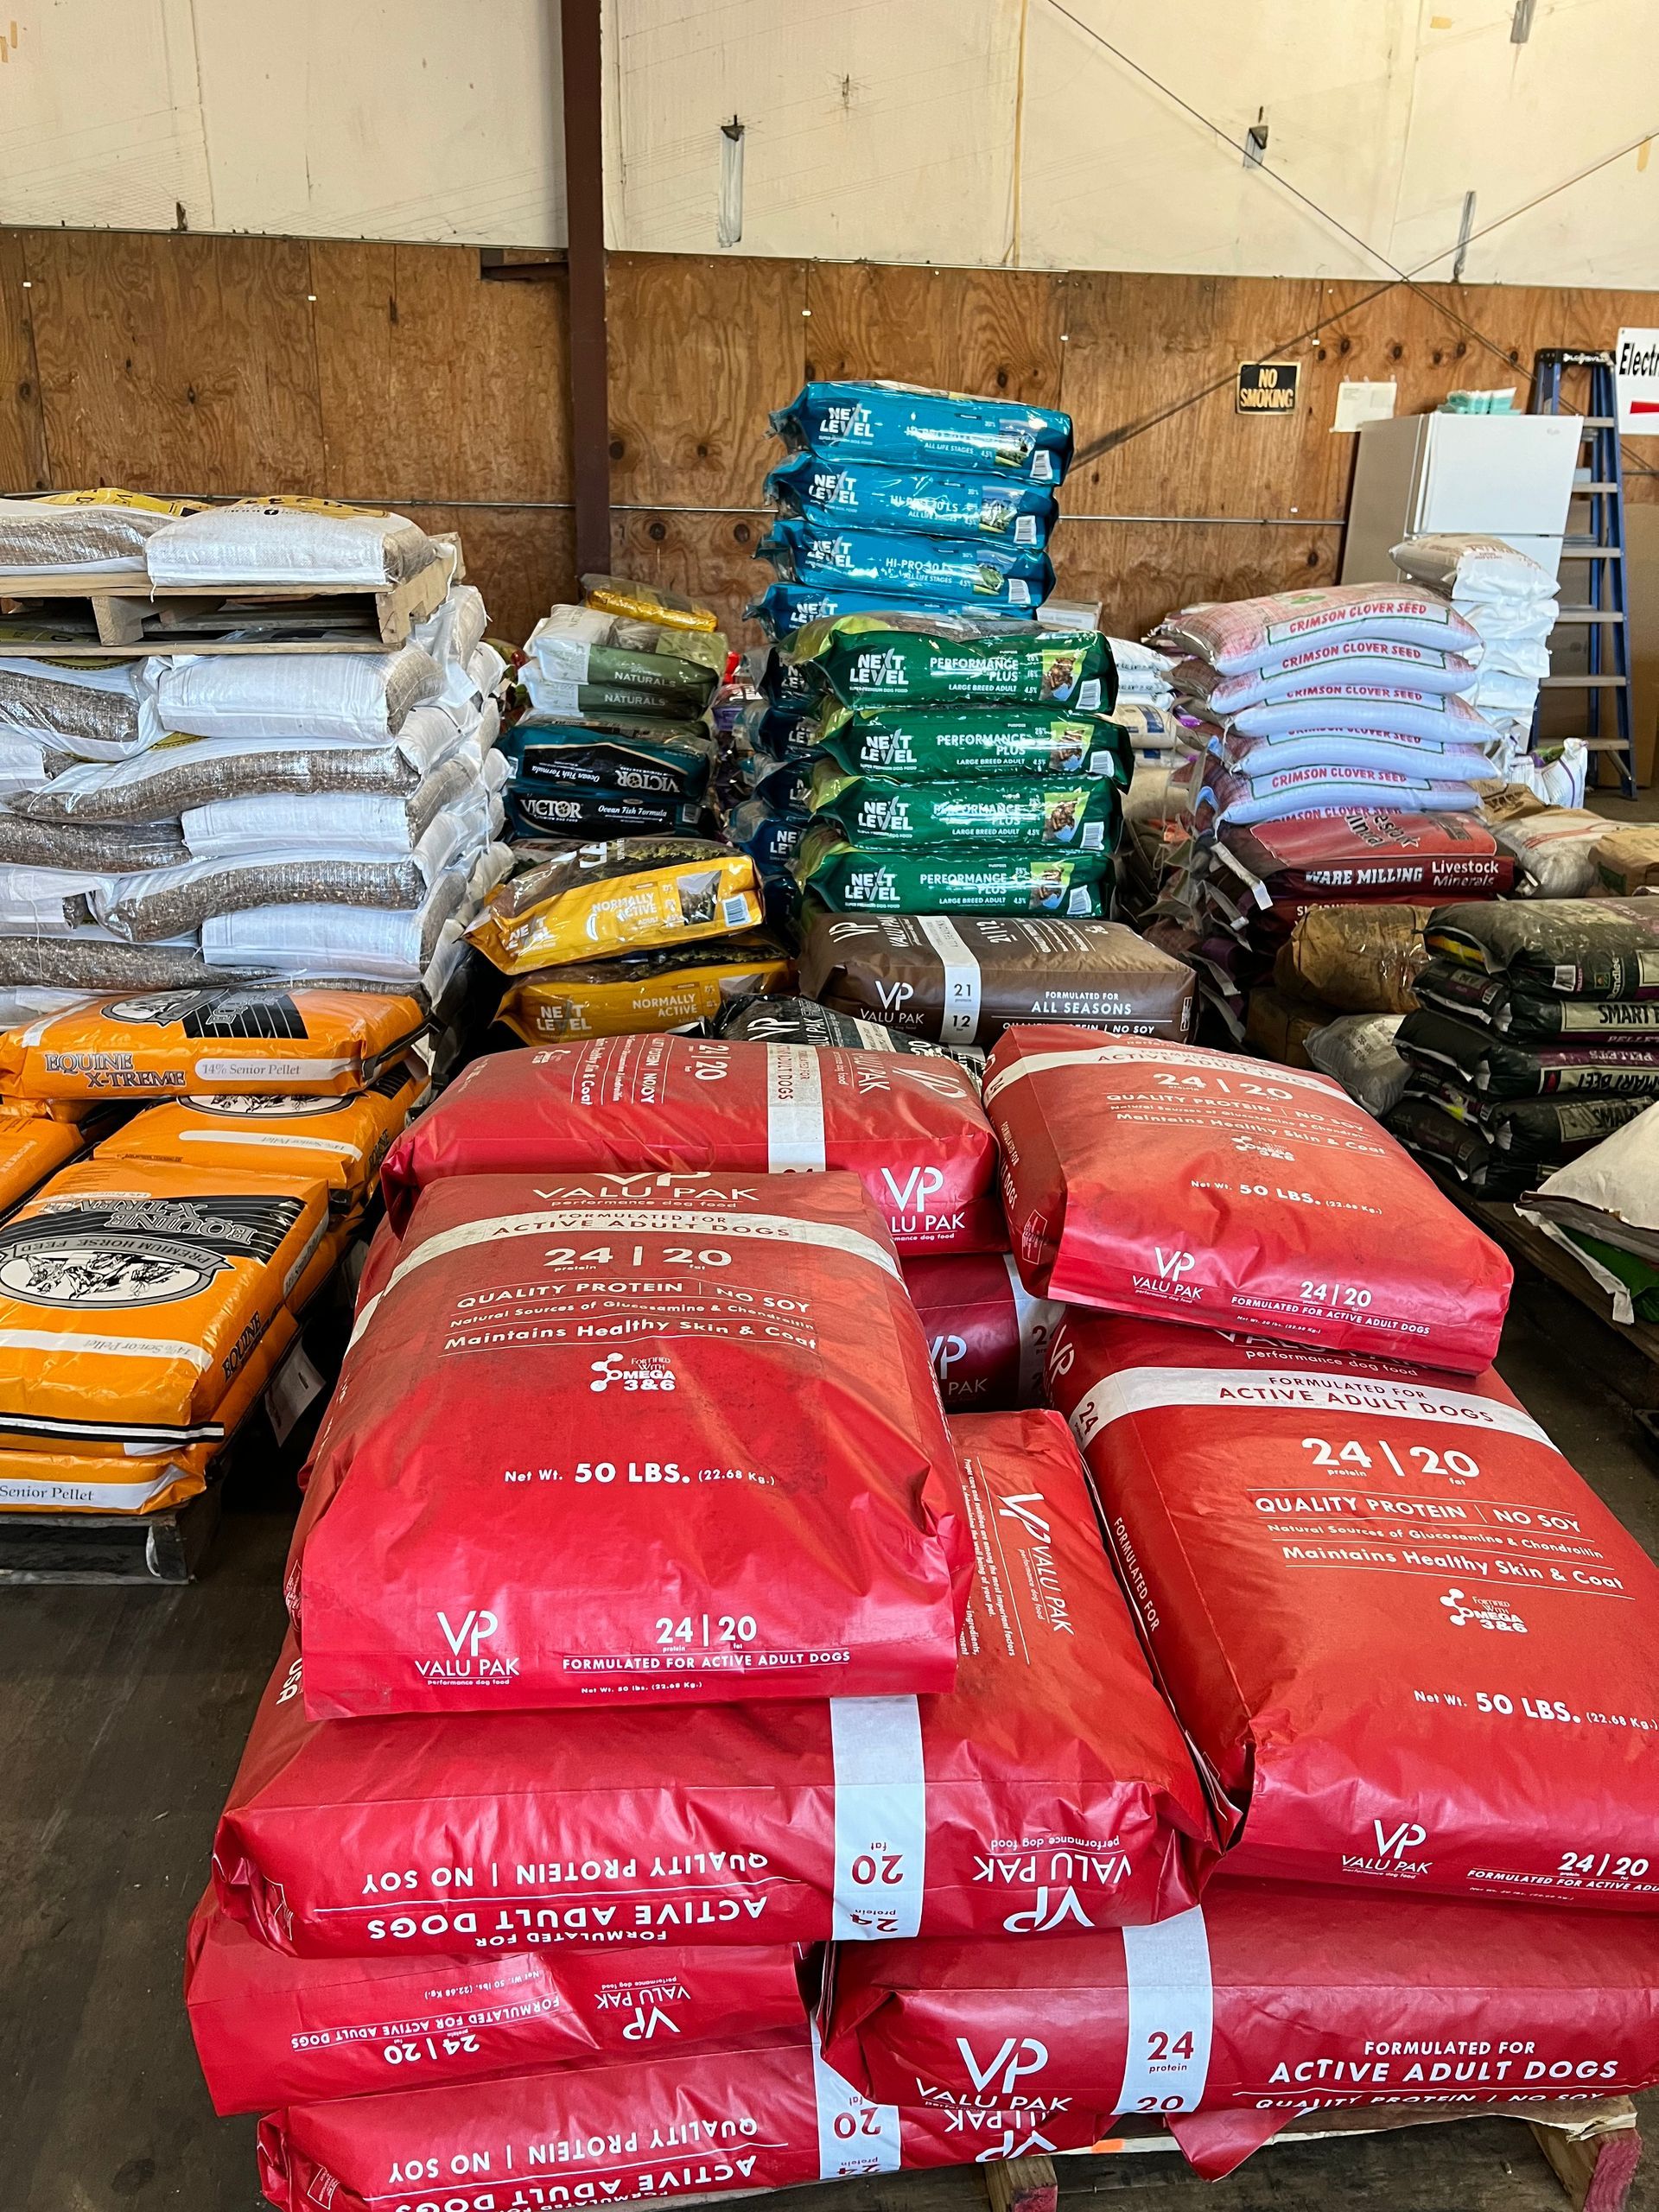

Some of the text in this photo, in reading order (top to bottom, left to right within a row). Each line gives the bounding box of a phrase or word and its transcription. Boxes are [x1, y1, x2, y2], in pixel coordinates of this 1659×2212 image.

[1258, 368, 1278, 388] NO
[1240, 388, 1294, 408] SMOKING
[819, 419, 874, 438] LEVEL
[934, 443, 950, 452] LIFE
[950, 445, 974, 454] STAGES
[1289, 602, 1427, 633] CRIMSON CLOVER SEED
[930, 657, 1019, 671] PERFORMANCE
[1281, 643, 1421, 669] CRIMSON CLOVER SEED
[614, 671, 677, 688] NATURALS
[849, 667, 909, 685] LEVEL
[988, 671, 1019, 683] PLUS
[972, 683, 994, 692] BREED
[1345, 686, 1390, 698] CLOVER
[1393, 691, 1423, 701] SEED
[604, 693, 667, 707] NATURALS
[937, 734, 1027, 747] PERFORMANCE
[861, 747, 917, 764] LEVEL
[996, 745, 1026, 756] PLUS
[614, 769, 681, 793] VICTOR
[1272, 766, 1408, 789] CRIMSON CLOVER SEED
[520, 799, 583, 819] VICTOR
[598, 804, 620, 814] Ocean
[857, 812, 913, 831] LEVEL
[1432, 861, 1499, 874] Livestock
[1305, 868, 1423, 886] WARE MILLING
[1433, 874, 1495, 887] Minerals
[844, 885, 900, 901] LEVEL
[592, 893, 655, 912] NORMALLY
[874, 980, 914, 1011] VP
[953, 983, 973, 997] 21
[1045, 991, 1119, 1001] FORMULATED FOR
[632, 994, 696, 1010] NORMALLY
[1030, 1001, 1133, 1016] ALL SEASONS
[658, 1004, 698, 1018] ACTIVE
[860, 1007, 926, 1024] VALU PAK
[1599, 1002, 1649, 1025] SMART
[951, 1014, 971, 1028] 12
[1112, 1023, 1156, 1035] NO SOY
[45, 1052, 134, 1073] EQUINE
[1588, 1049, 1654, 1062] PELLETS
[202, 1064, 302, 1076] 14% Senior Pellet
[87, 1071, 186, 1088] X-TREME
[531, 1186, 761, 1201] VALU PAK
[880, 1166, 944, 1213] VP
[557, 1212, 683, 1221] FORMULATED
[925, 1211, 965, 1231] PAK
[104, 1211, 259, 1245] EQUINE
[491, 1219, 791, 1236] ACTIVE ADULT DOGS
[21, 1237, 211, 1264] PREMIUM HORSE FEED
[543, 1247, 733, 1267] 24 20
[456, 1282, 812, 1314] QUALITY PROTEIN NO SOY
[449, 1300, 815, 1331] Natural Sources of Glucosamine & Chondroitin
[1230, 1296, 1431, 1336] FORMULATED FOR ACTIVE ADULT DOGS
[443, 1319, 817, 1351] Maintains Healthy Skin & Coat
[606, 1369, 677, 1381] OMEGA
[622, 1380, 677, 1391] 3&6
[1219, 1387, 1495, 1423] ACTIVE ADULT DOGS
[1301, 1437, 1481, 1478] 24 20
[504, 1462, 775, 1486] Net Wt. 50 LBS. (22.68 Kg.)
[0, 1485, 94, 1501] Senior Pellet
[562, 1649, 852, 1671] FORMULATED FOR ACTIVE ADULT DOGS
[360, 1850, 769, 1895] QUALITY PROTEIN NO SOY
[368, 1896, 769, 1941] ACTIVE ADULT DOGS
[1147, 2031, 1194, 2061] 24
[1363, 2041, 1535, 2056] FORMULATED FOR
[1148, 2063, 1188, 2074] protein
[1268, 2058, 1619, 2083] ACTIVE ADULT DOGS
